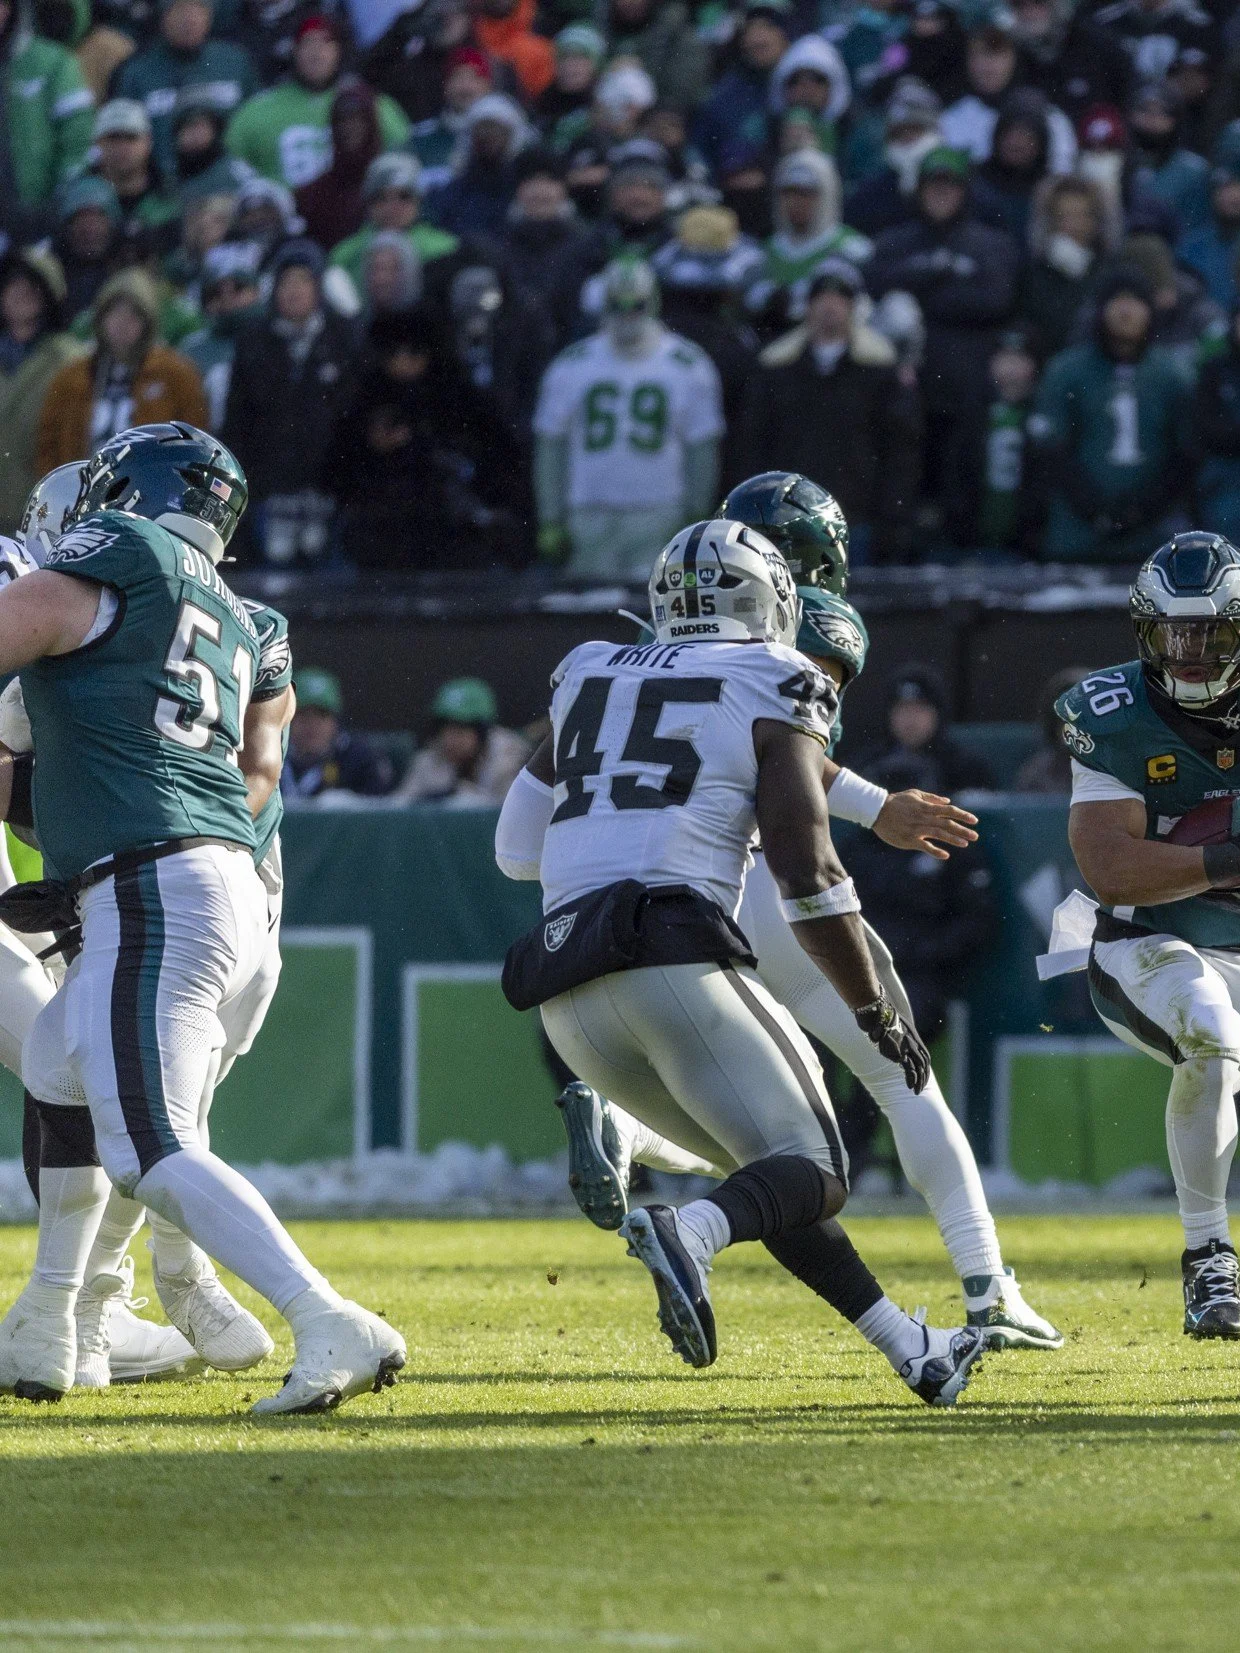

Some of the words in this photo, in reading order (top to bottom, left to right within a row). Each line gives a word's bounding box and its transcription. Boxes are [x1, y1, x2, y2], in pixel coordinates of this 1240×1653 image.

[583, 381, 668, 453] 69
[670, 623, 720, 638] RAIDERS
[154, 599, 252, 768] 51
[1081, 672, 1135, 717] 26
[550, 676, 728, 825] 45
[1147, 754, 1176, 779] C
